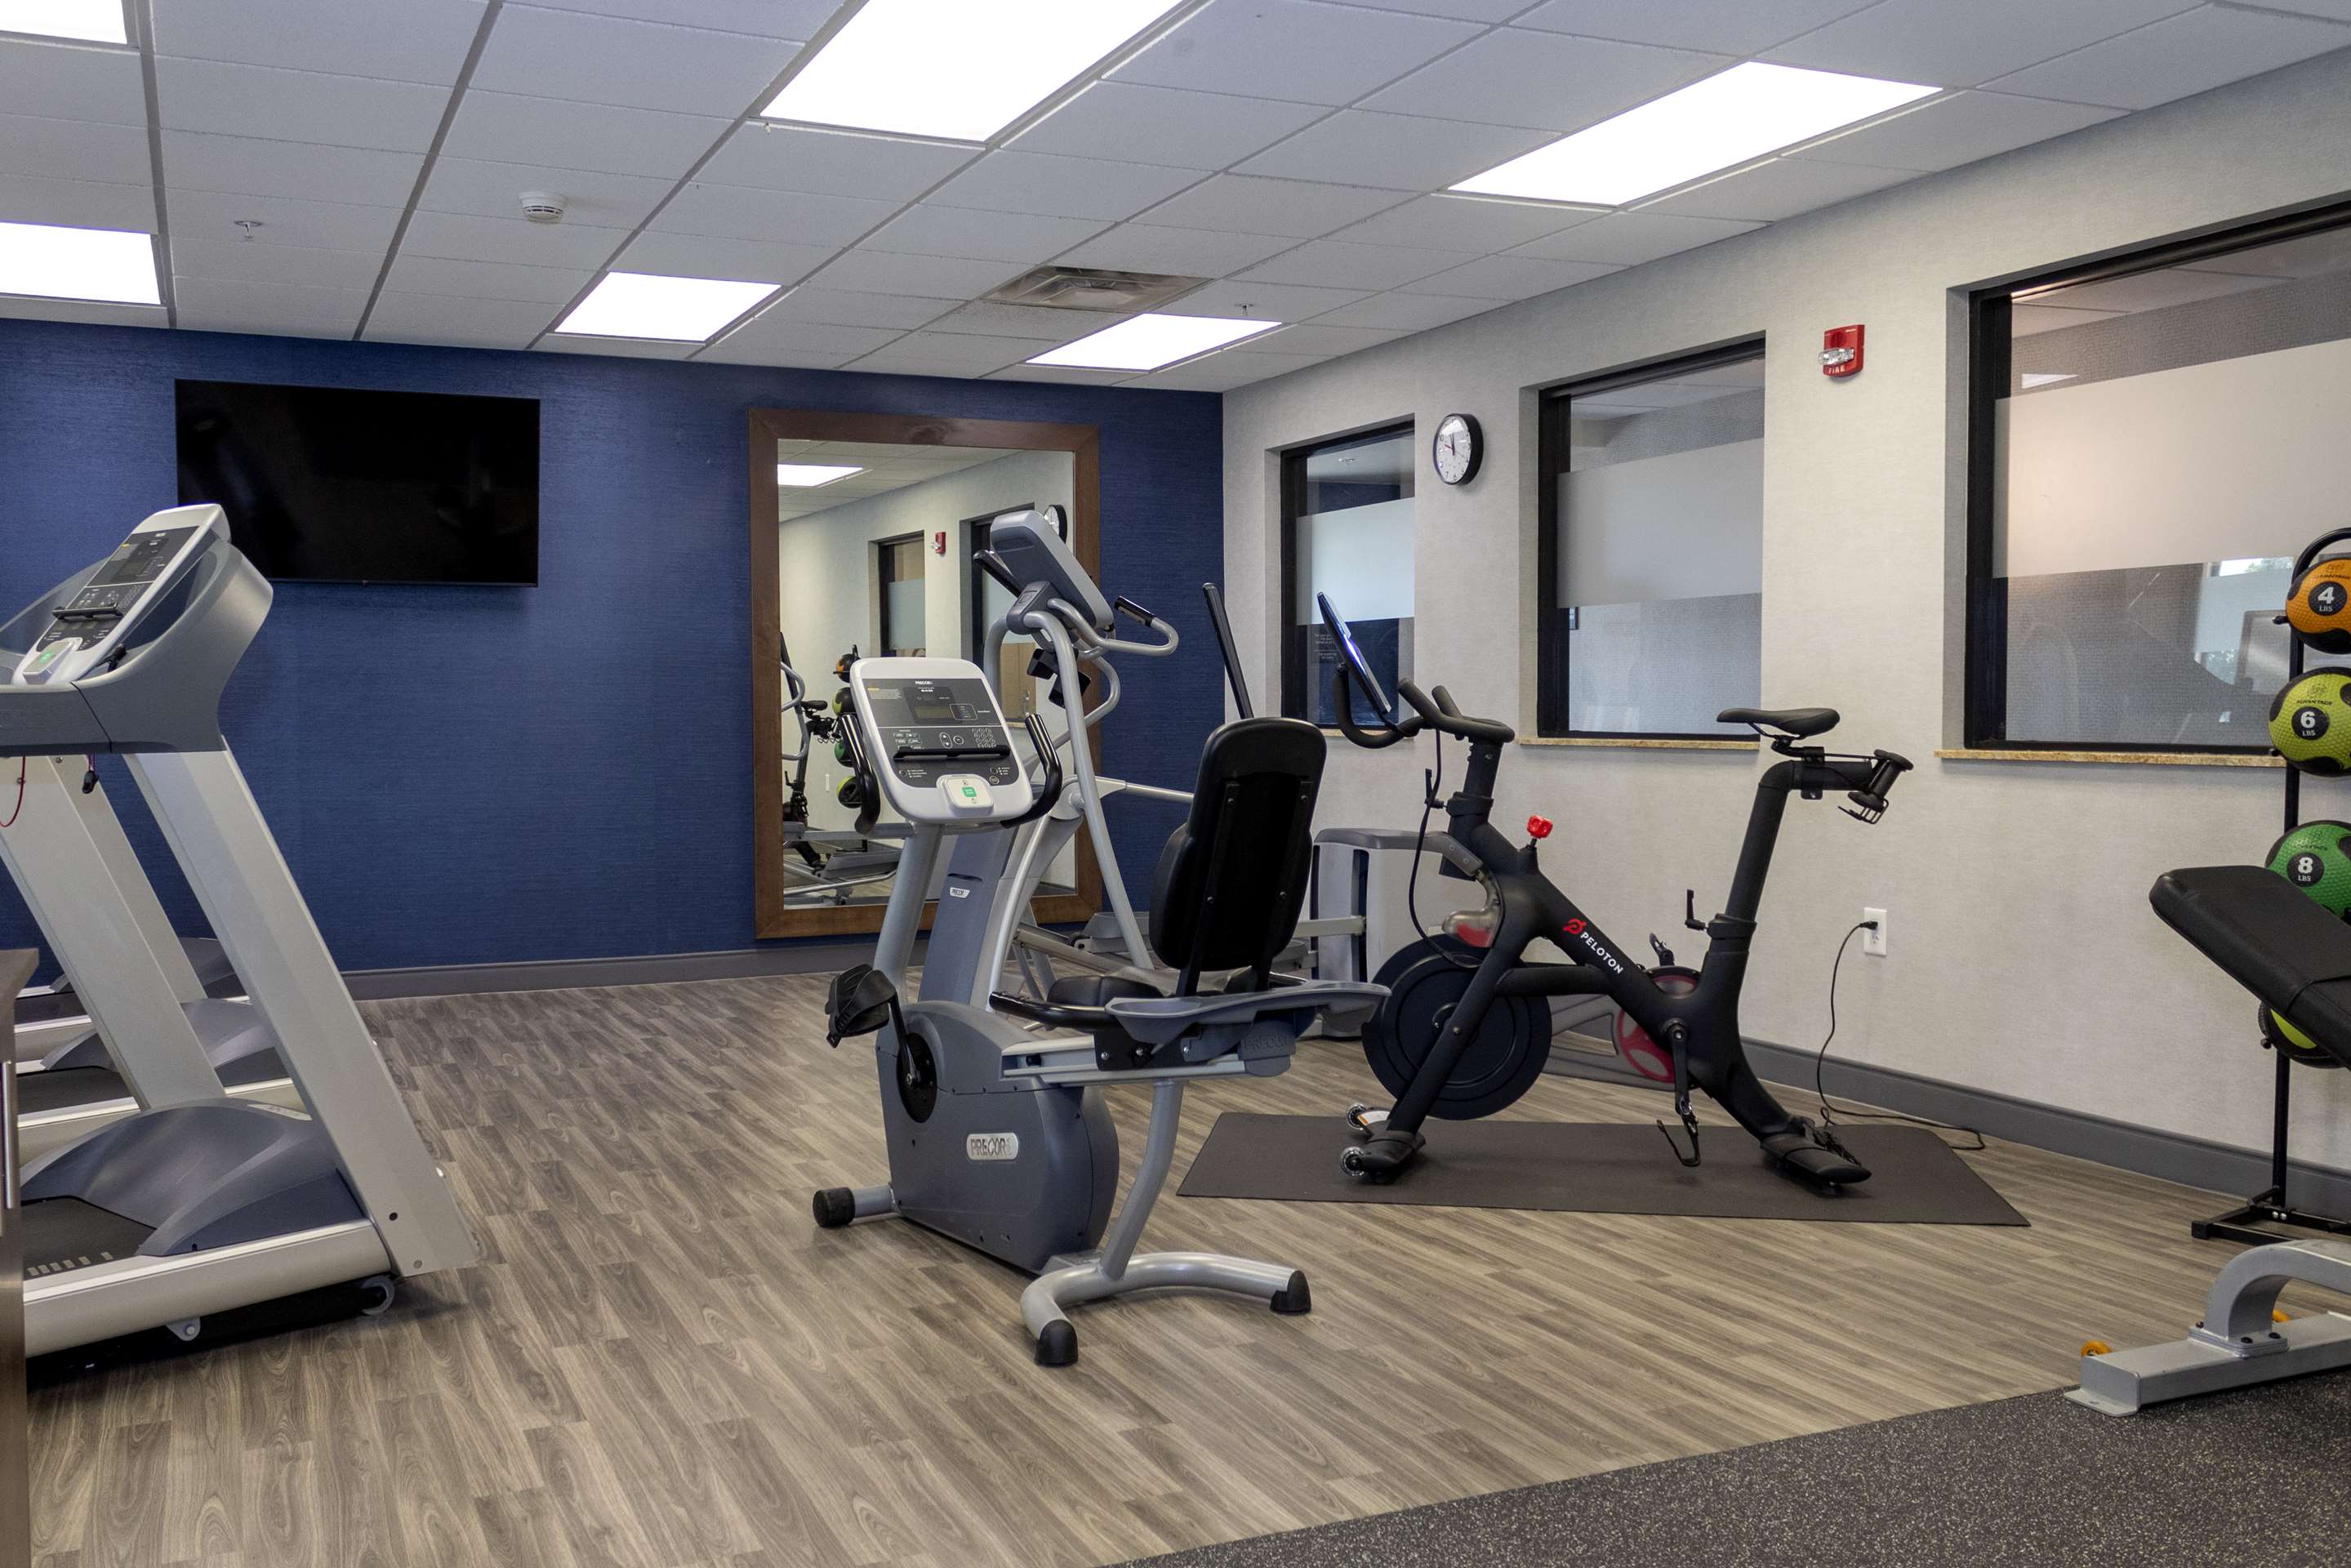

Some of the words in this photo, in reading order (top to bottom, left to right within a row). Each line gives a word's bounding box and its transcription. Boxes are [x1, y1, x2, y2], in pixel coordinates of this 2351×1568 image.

[1829, 365, 1846, 374] FIRE
[2318, 586, 2335, 604] 4
[2300, 710, 2316, 728] 6
[2298, 857, 2313, 874] 8
[1580, 931, 1623, 974] PELOTON
[970, 1138, 1008, 1157] PRECOR
